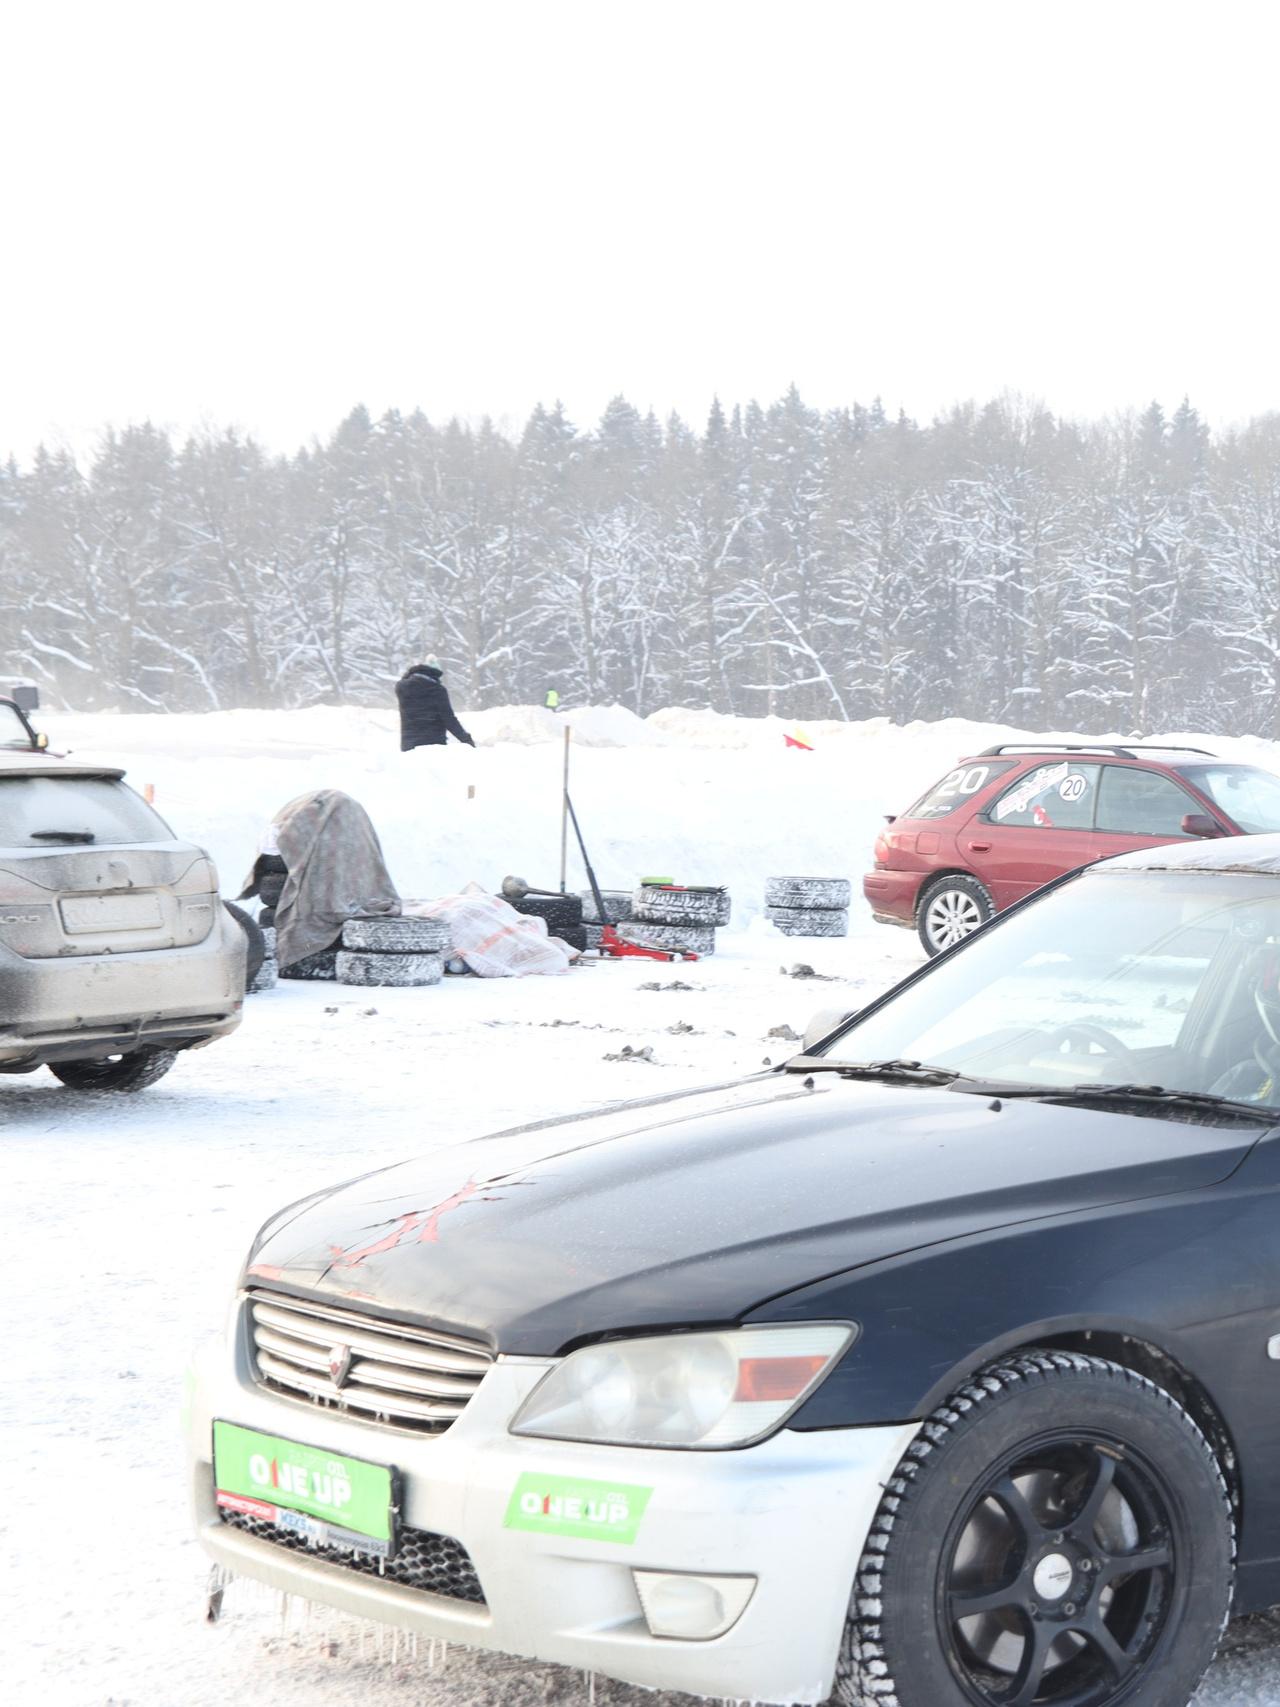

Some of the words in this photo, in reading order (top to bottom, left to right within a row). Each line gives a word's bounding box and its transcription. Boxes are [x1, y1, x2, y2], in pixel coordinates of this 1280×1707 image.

[936, 766, 990, 798] 20
[1063, 779, 1083, 797] 20
[249, 1454, 310, 1498] ONE
[312, 1471, 352, 1508] UP
[520, 1492, 583, 1519] ONE
[586, 1500, 630, 1525] UP
